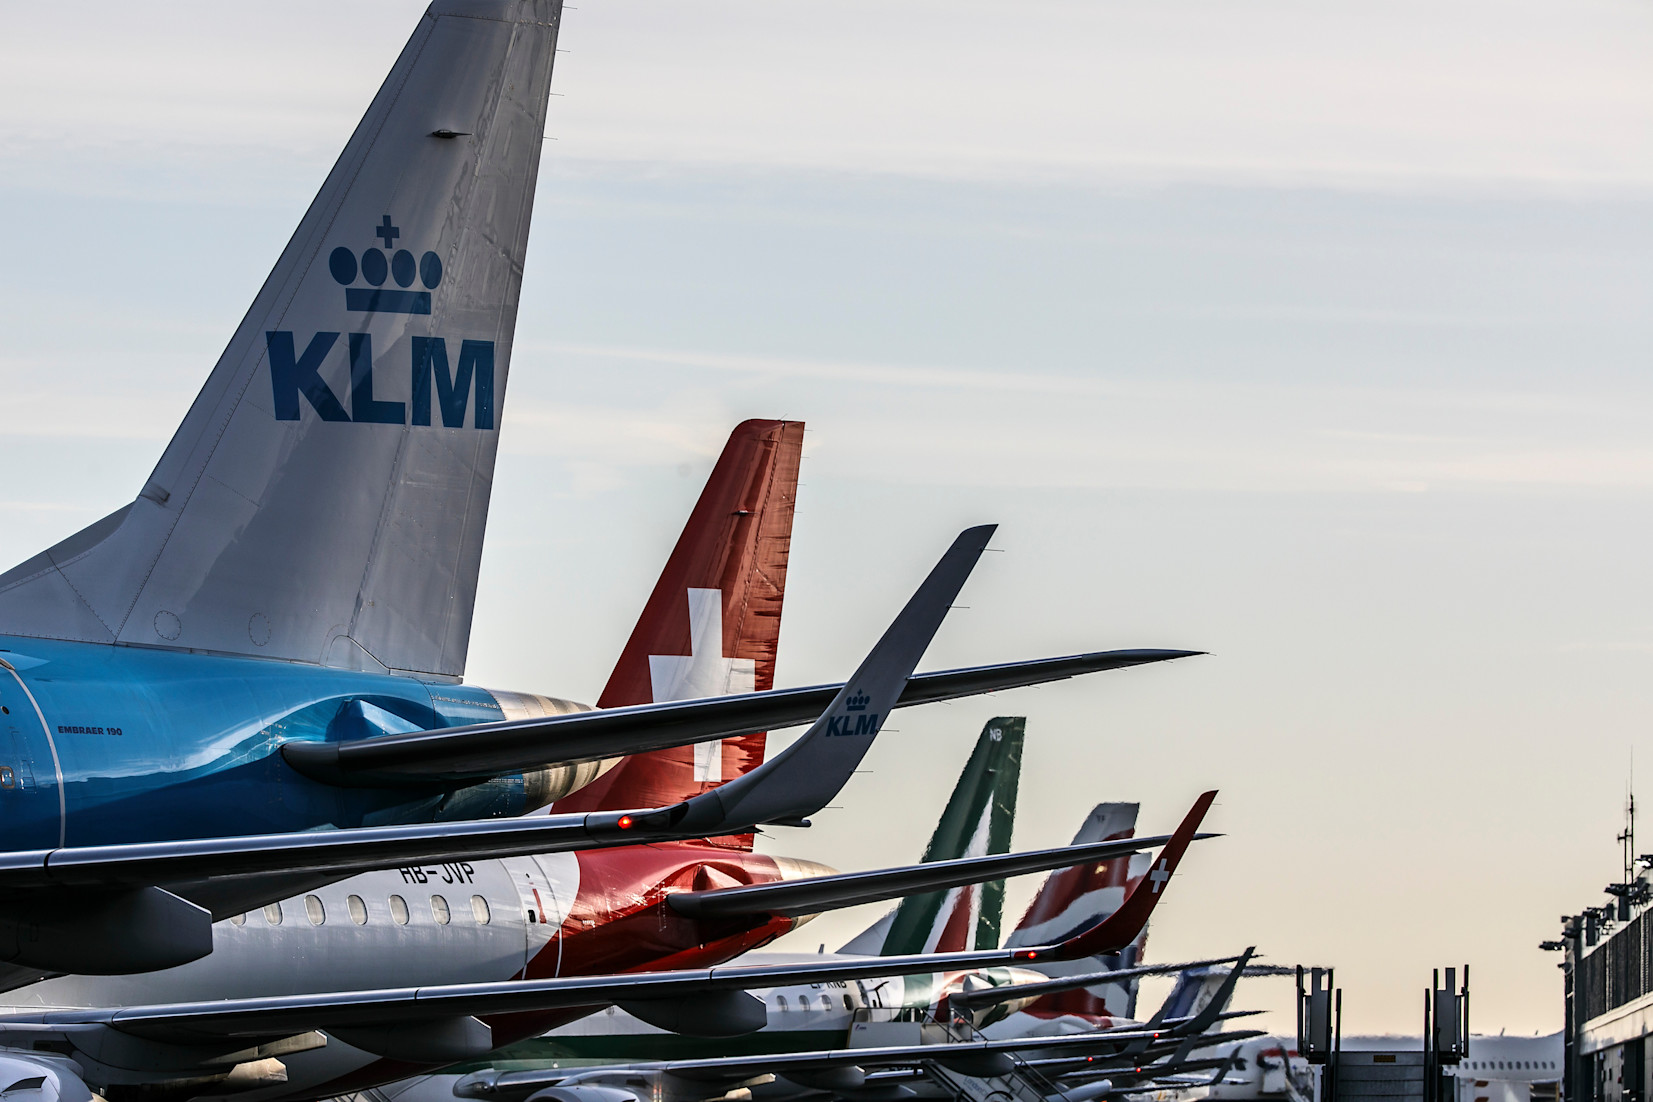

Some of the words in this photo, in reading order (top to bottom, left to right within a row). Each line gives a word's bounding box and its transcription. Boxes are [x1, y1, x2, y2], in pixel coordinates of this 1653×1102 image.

[266, 331, 494, 430] KLM
[58, 726, 104, 735] EMBRAER
[106, 728, 122, 736] 190
[826, 714, 878, 737] KLM
[990, 728, 1002, 741] NB
[399, 863, 474, 884] HB-JVP
